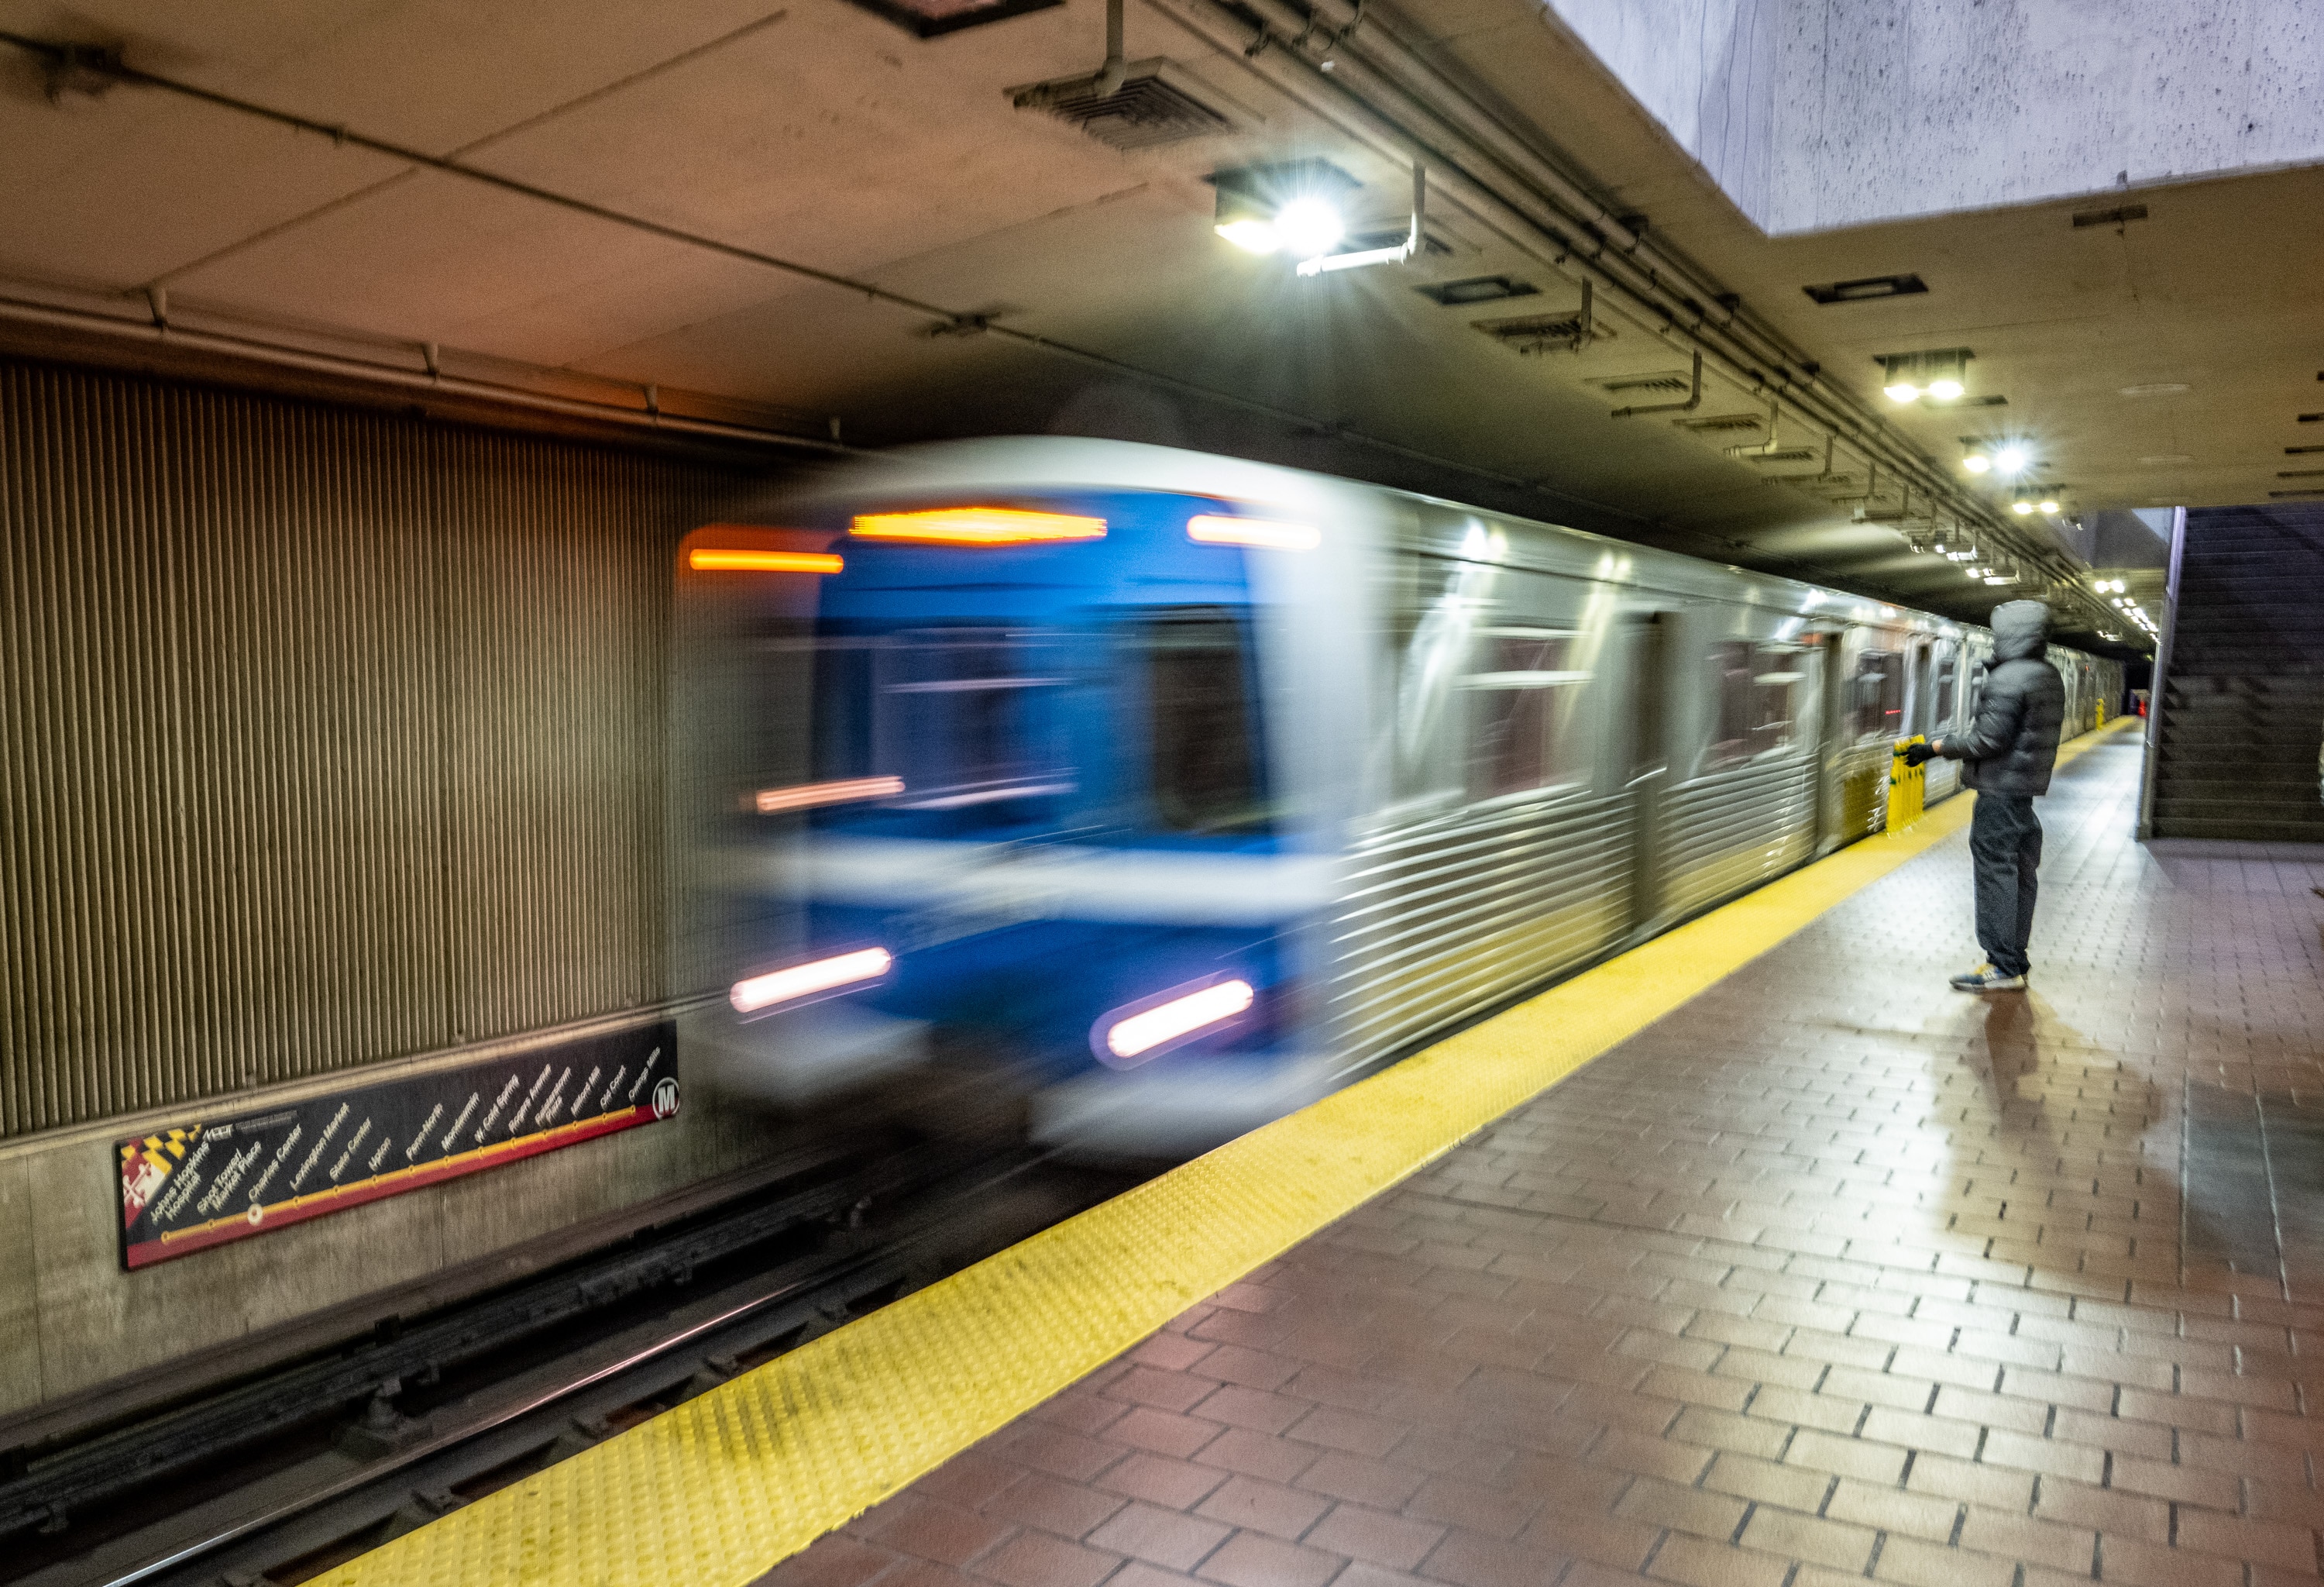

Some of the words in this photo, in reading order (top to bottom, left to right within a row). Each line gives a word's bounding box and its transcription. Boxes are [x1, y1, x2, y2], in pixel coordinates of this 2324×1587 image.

[483, 1103, 500, 1131] Cold
[497, 1074, 520, 1109] Spring
[508, 1096, 531, 1134] Rogers
[529, 1063, 552, 1101] Avenue
[535, 1066, 572, 1127] Reisterstown
[571, 1082, 591, 1117] Milford
[589, 1065, 602, 1087] Mill
[600, 1089, 613, 1110] Old
[610, 1065, 627, 1094] Court
[628, 1067, 648, 1102] Owings
[647, 1046, 661, 1069] Mills
[658, 1084, 676, 1114] M
[406, 1103, 444, 1161] Penn-North
[441, 1092, 480, 1152] Mondawmin
[545, 1095, 564, 1125] Plaza
[249, 1159, 280, 1202] Charles
[277, 1123, 302, 1162] Center
[289, 1137, 327, 1191] Lexington
[323, 1102, 349, 1141] Market
[329, 1151, 350, 1182] State
[347, 1117, 372, 1155] Center
[368, 1137, 391, 1172] Upton
[150, 1186, 177, 1226] Johns
[174, 1141, 210, 1189] Hopkins
[165, 1172, 201, 1221] Hospital
[198, 1185, 220, 1216] Shot
[210, 1171, 241, 1213] Market
[237, 1141, 262, 1176] Place
